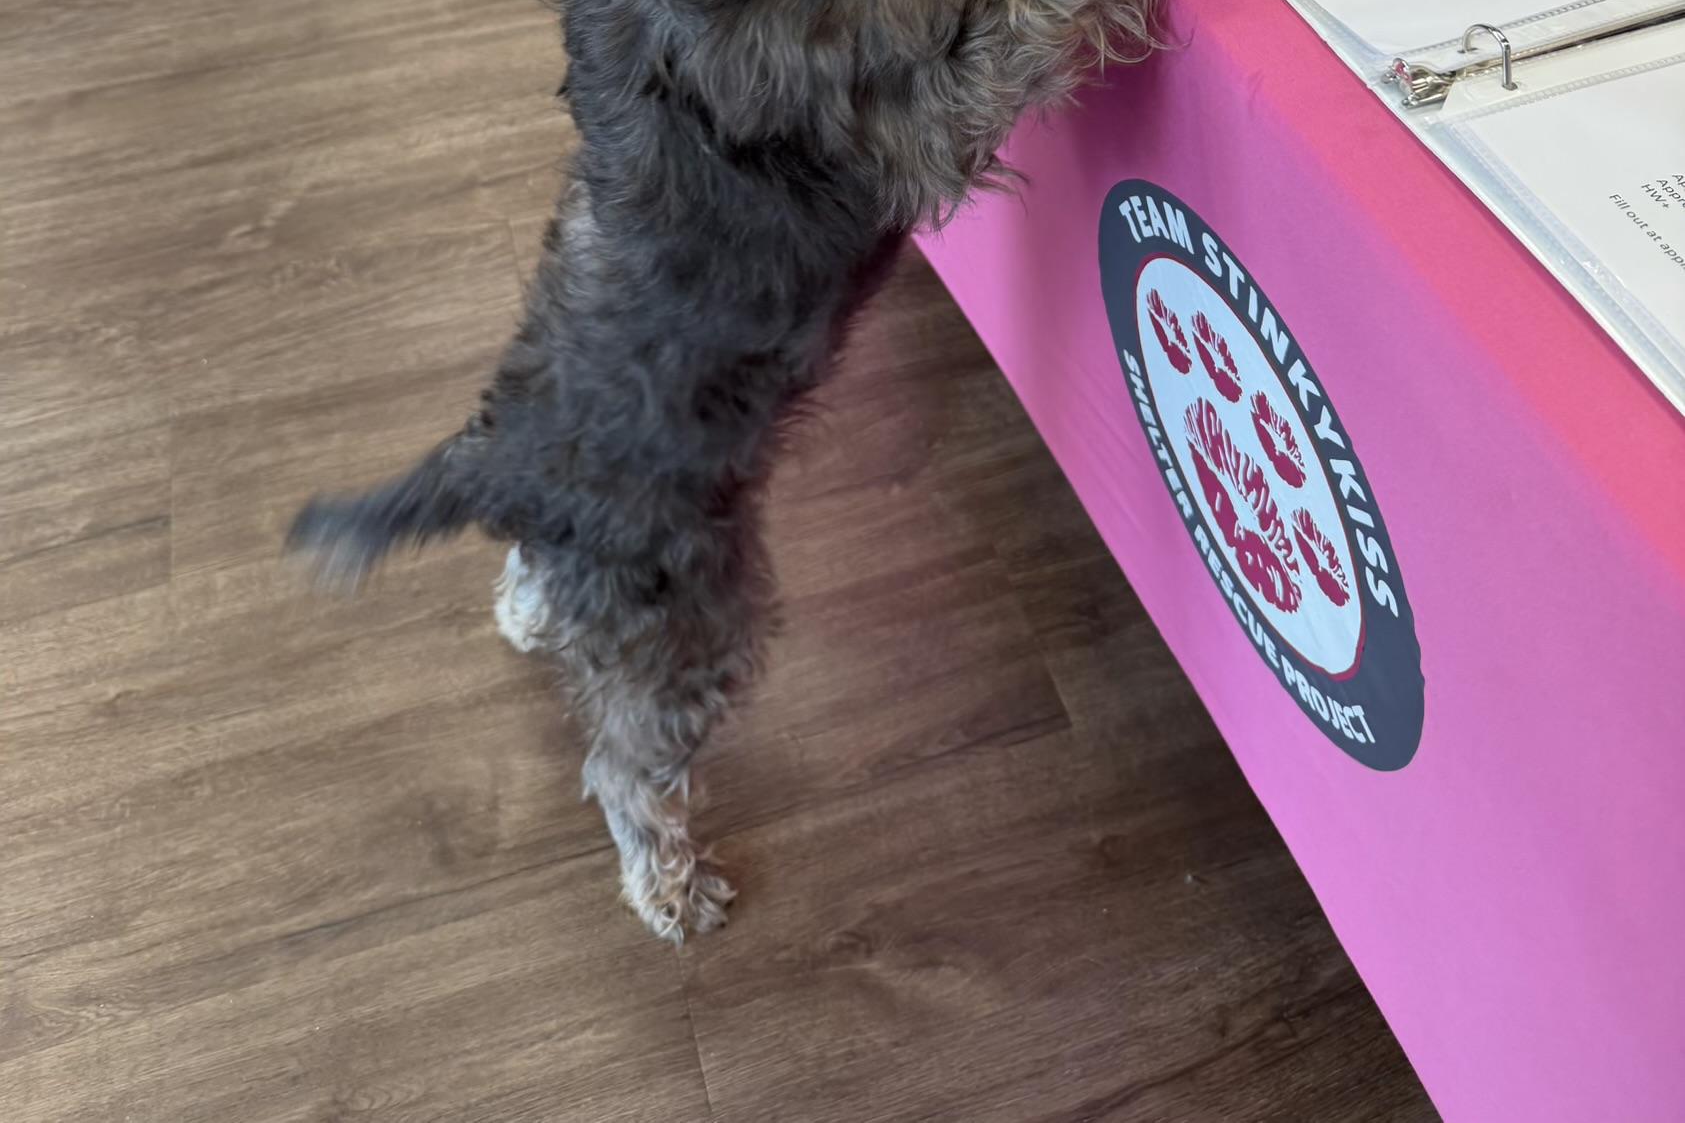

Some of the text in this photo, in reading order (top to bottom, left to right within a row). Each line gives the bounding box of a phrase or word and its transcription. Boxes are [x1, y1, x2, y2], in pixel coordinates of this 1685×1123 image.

[1609, 194, 1631, 210] Fill
[1626, 211, 1648, 229] out
[1646, 230, 1662, 242] at
[1641, 183, 1669, 209] HW+
[1119, 194, 1398, 618] TEAM STINKYKISS
[1123, 348, 1377, 746] SHELTER RESCUE PROJECT
